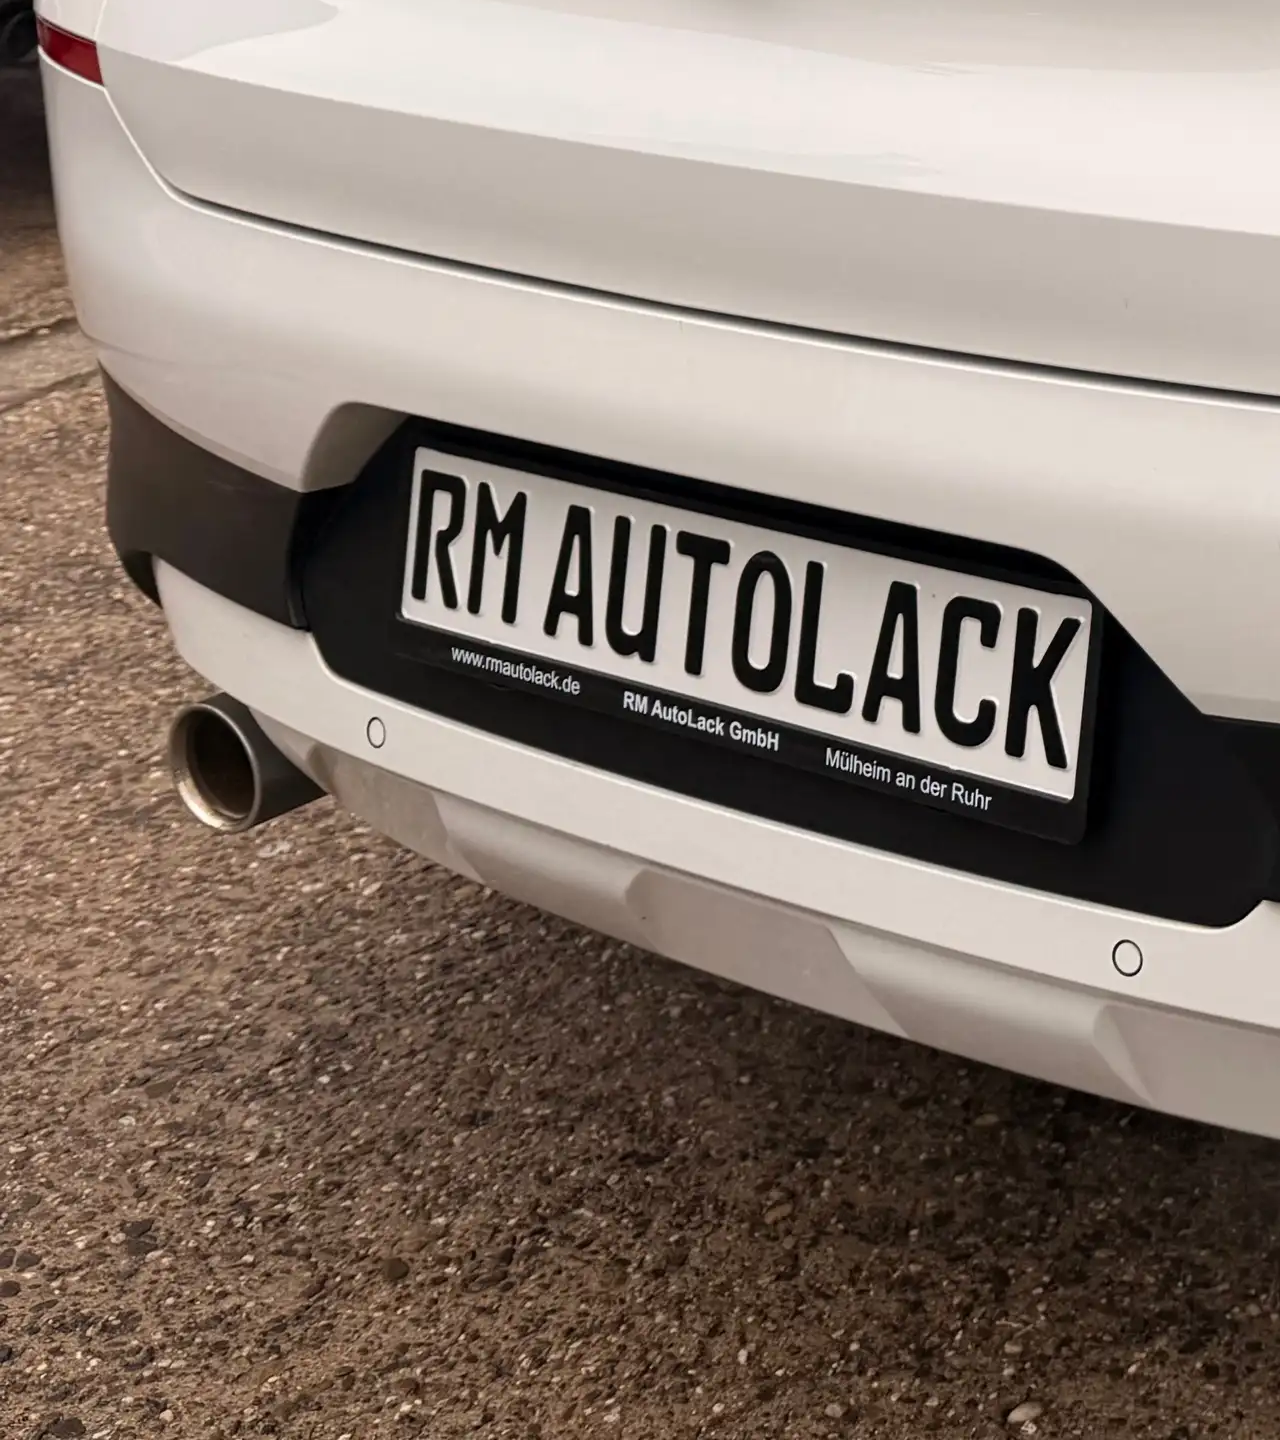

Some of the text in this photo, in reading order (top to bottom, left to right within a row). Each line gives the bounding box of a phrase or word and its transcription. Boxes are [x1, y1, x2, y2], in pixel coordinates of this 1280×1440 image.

[410, 468, 1083, 770] RM AUTOLACK
[451, 646, 581, 695] www.rmautolack.de
[622, 690, 780, 752] RM AutoLack GmbH
[825, 747, 993, 811] Mülheim an der Ruhr
